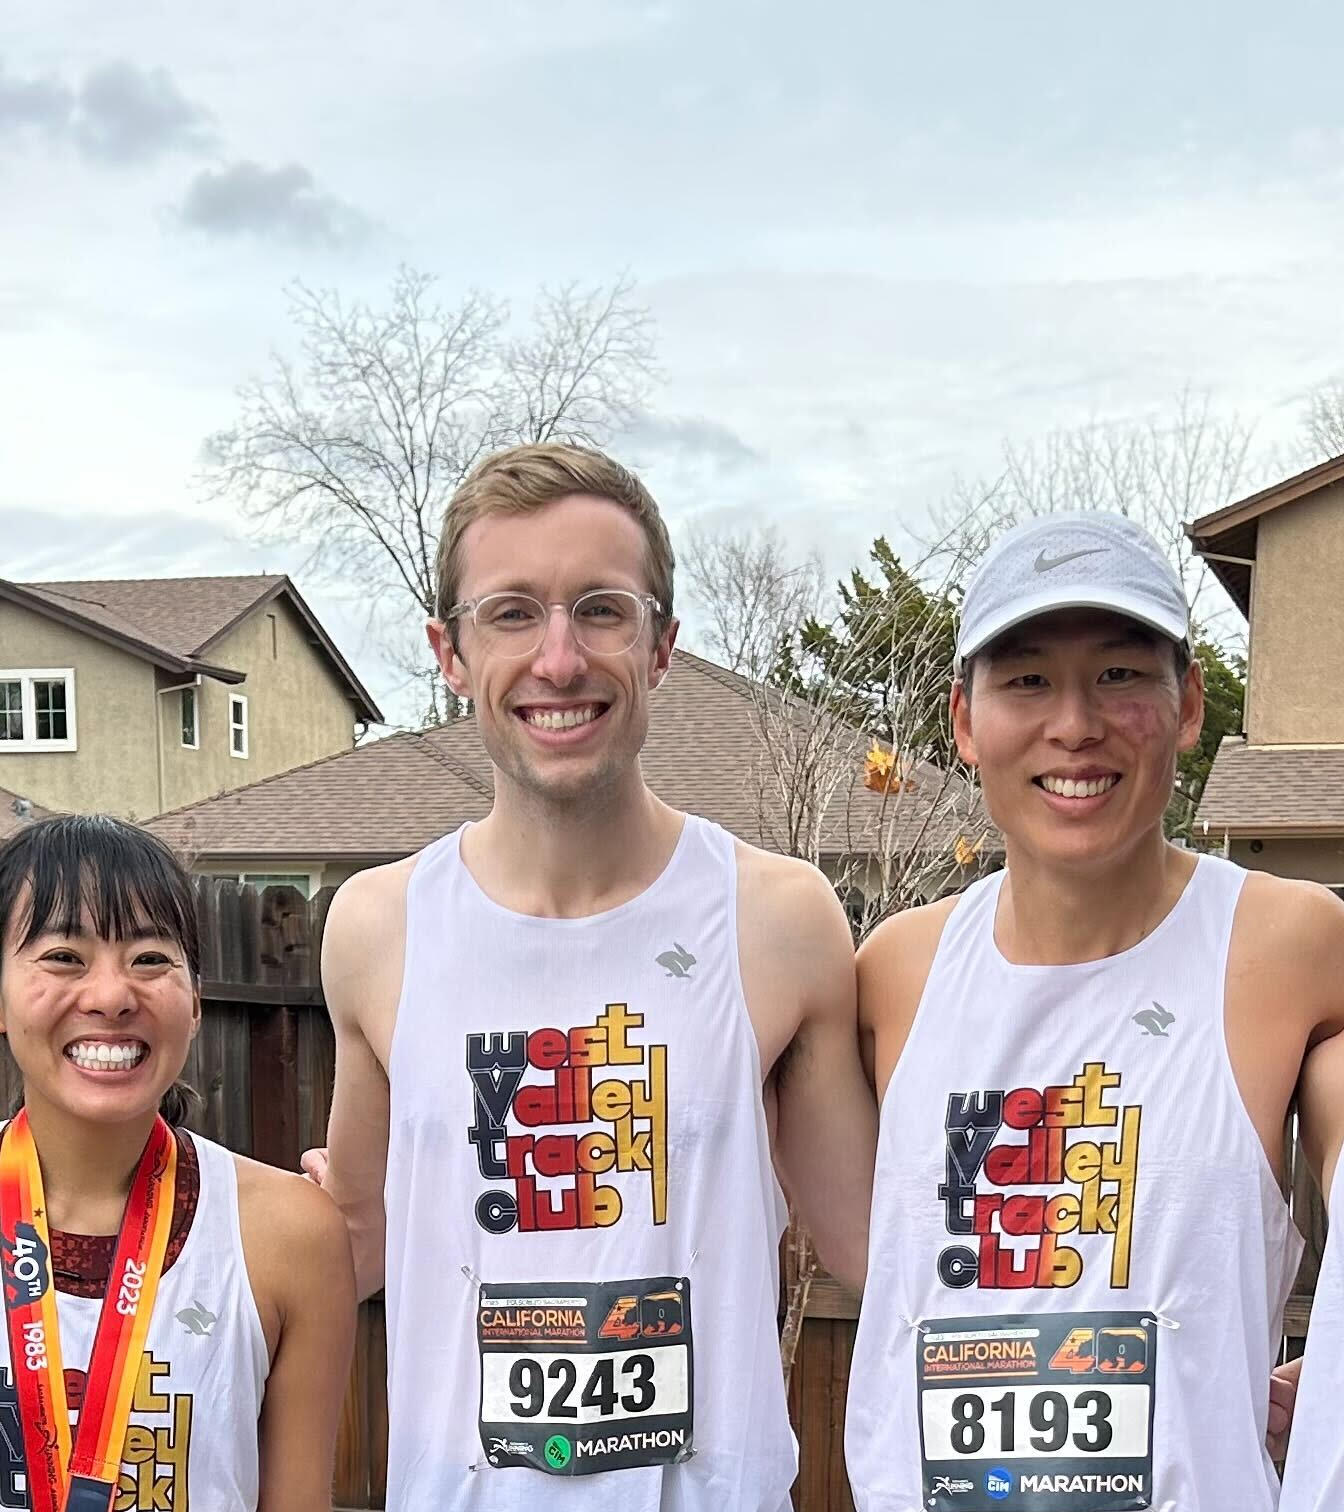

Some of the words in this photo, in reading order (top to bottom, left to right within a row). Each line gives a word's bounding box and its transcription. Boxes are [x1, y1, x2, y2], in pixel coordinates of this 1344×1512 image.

[466, 1003, 645, 1071] west
[945, 1062, 1122, 1130] west
[474, 1173, 623, 1235] club
[116, 1257, 147, 1317] 2023
[937, 1232, 1084, 1290] club
[22, 1320, 48, 1371] 1983
[480, 1309, 586, 1327] CALIFORNIA
[923, 1341, 1037, 1363] CALIFORNIA
[509, 1354, 657, 1418] 9243
[576, 1429, 685, 1458] MARATHON
[950, 1390, 1113, 1455] 8193
[987, 1480, 1010, 1493] CIM
[1020, 1474, 1143, 1493] MARATHON
